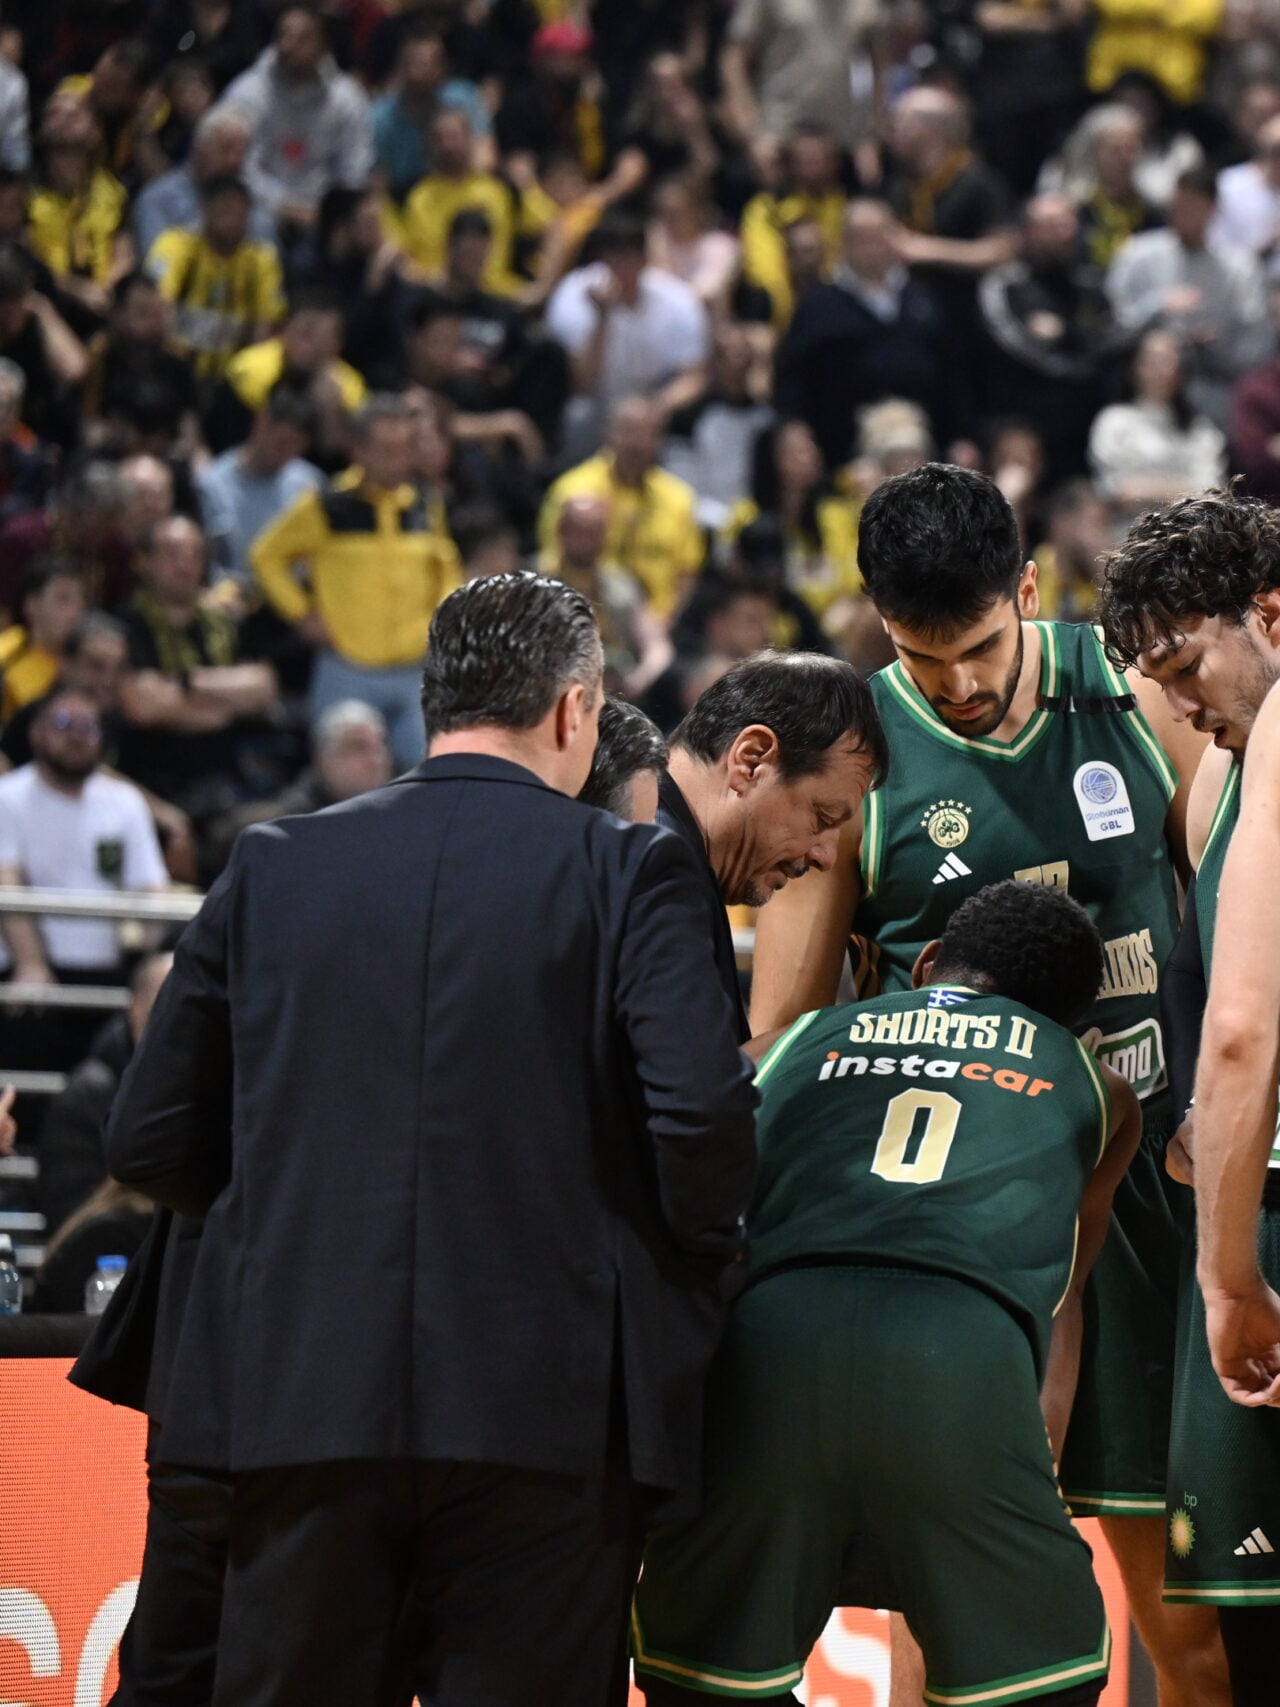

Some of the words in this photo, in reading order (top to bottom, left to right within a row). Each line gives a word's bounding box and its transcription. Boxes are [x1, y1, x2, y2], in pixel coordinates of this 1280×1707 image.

[1100, 820, 1122, 831] GBL
[850, 1009, 1001, 1049] SHORTS
[818, 1052, 1054, 1097] instacar
[870, 1087, 962, 1184] 0
[1184, 1491, 1198, 1508] bp
